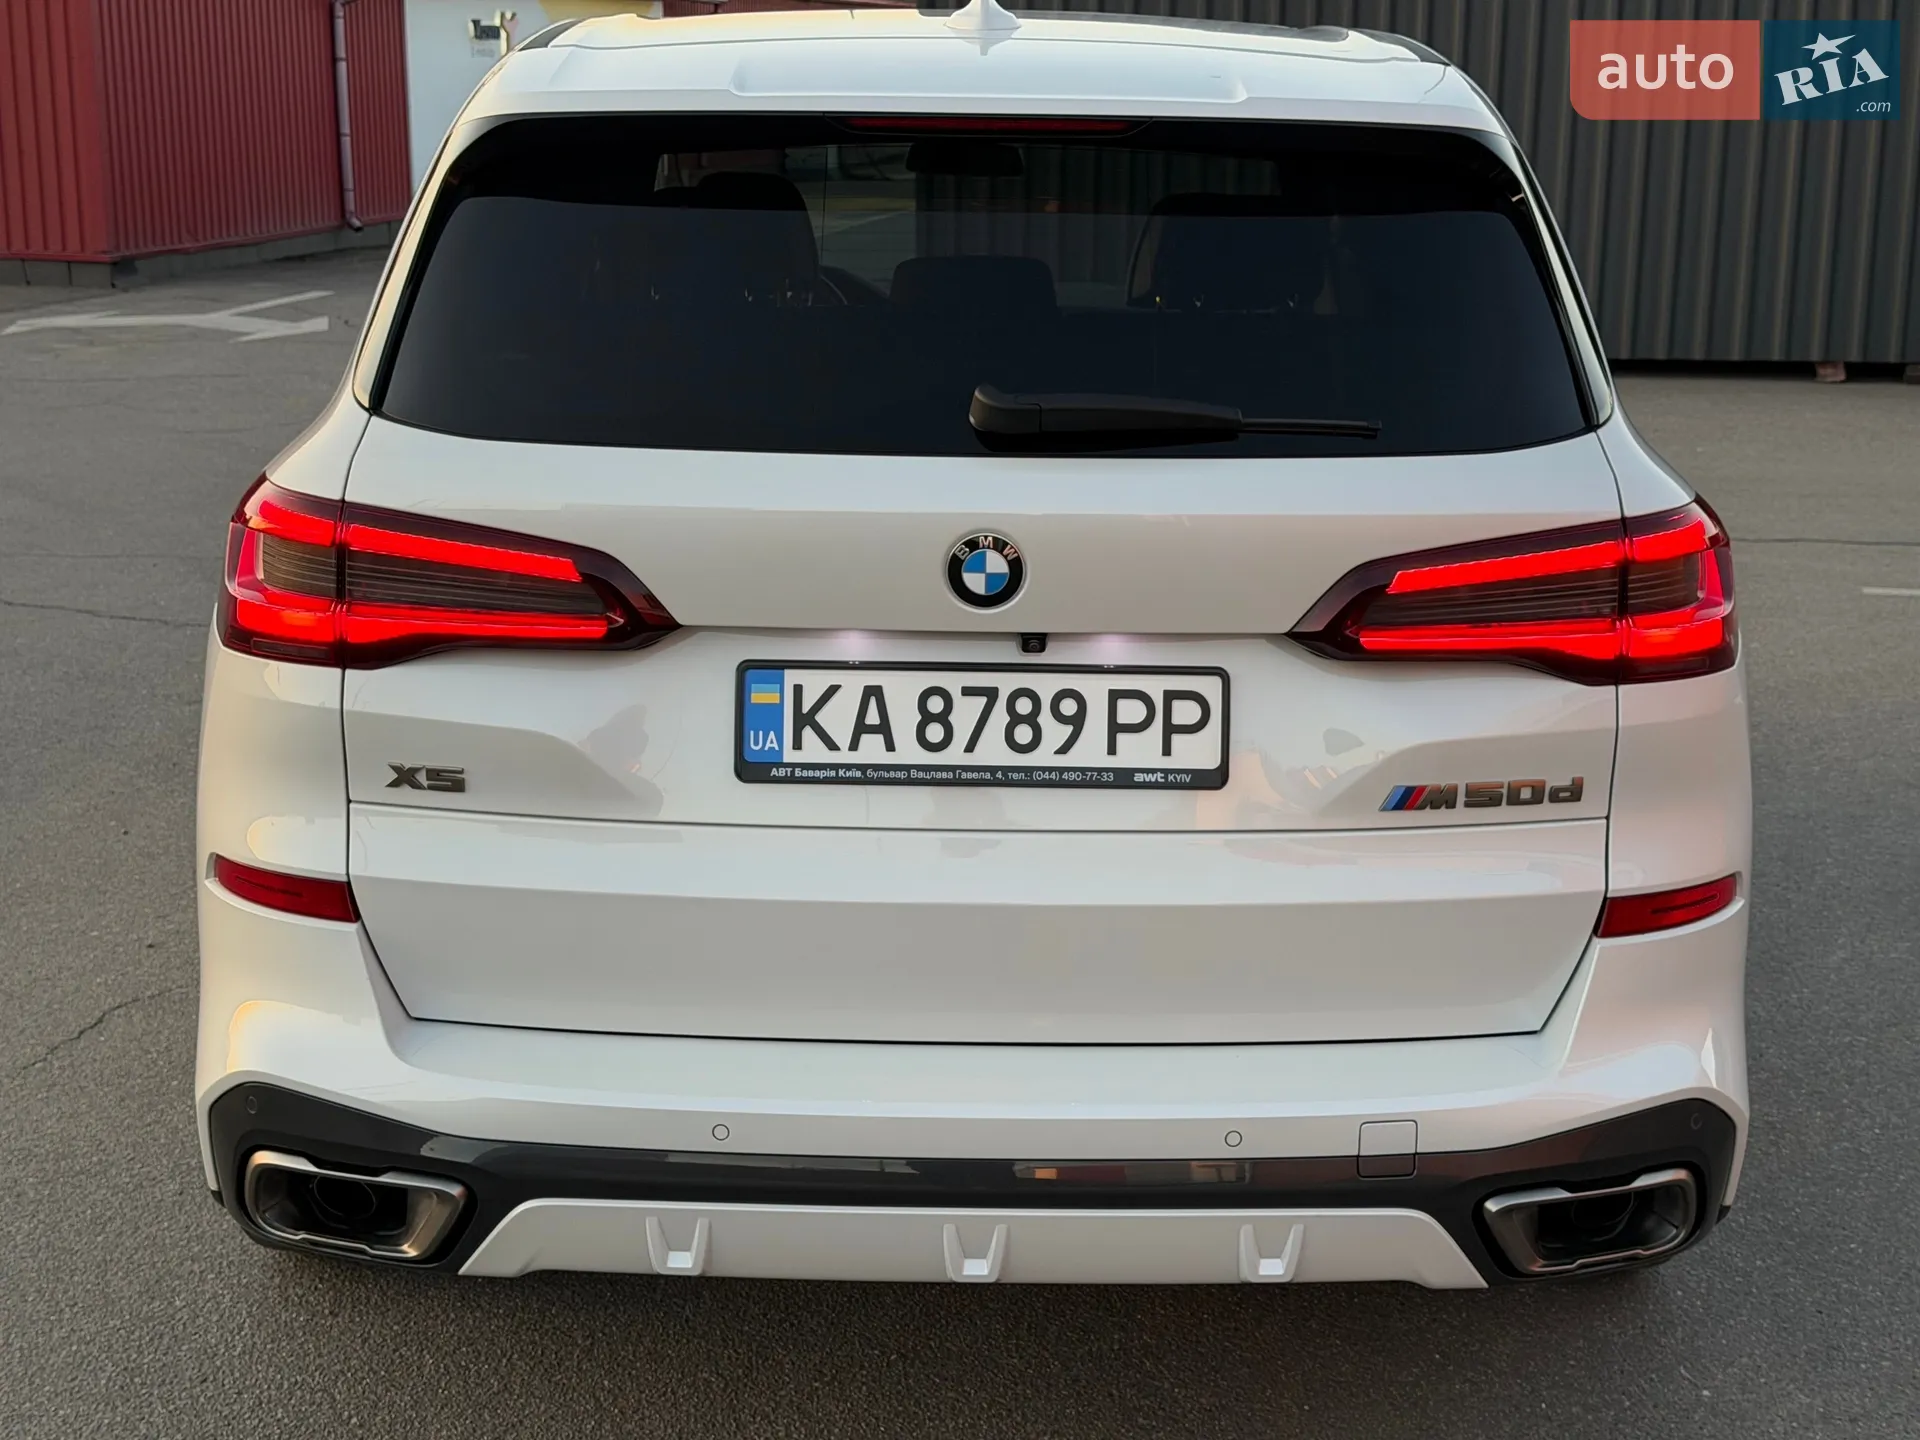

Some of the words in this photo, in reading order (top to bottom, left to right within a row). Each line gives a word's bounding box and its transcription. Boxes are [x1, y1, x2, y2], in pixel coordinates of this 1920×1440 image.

[954, 536, 1018, 560] BMW
[791, 683, 897, 753] KA
[915, 685, 1088, 757] 8789
[1106, 688, 1212, 758] PP
[748, 729, 780, 752] UA
[385, 761, 466, 793] X5
[770, 767, 793, 777] АВТ
[794, 767, 836, 779] Баварія
[838, 768, 864, 779] Київ,
[866, 768, 908, 780] бульвар
[910, 769, 953, 780] Вацлава
[956, 769, 994, 780] Гавела,
[995, 770, 1005, 781] 4,
[1007, 771, 1030, 780] тел.:
[1032, 770, 1060, 781] (044)
[1062, 771, 1114, 782] 490-77-33
[1133, 771, 1165, 782] awt
[1168, 773, 1192, 783] KYIV
